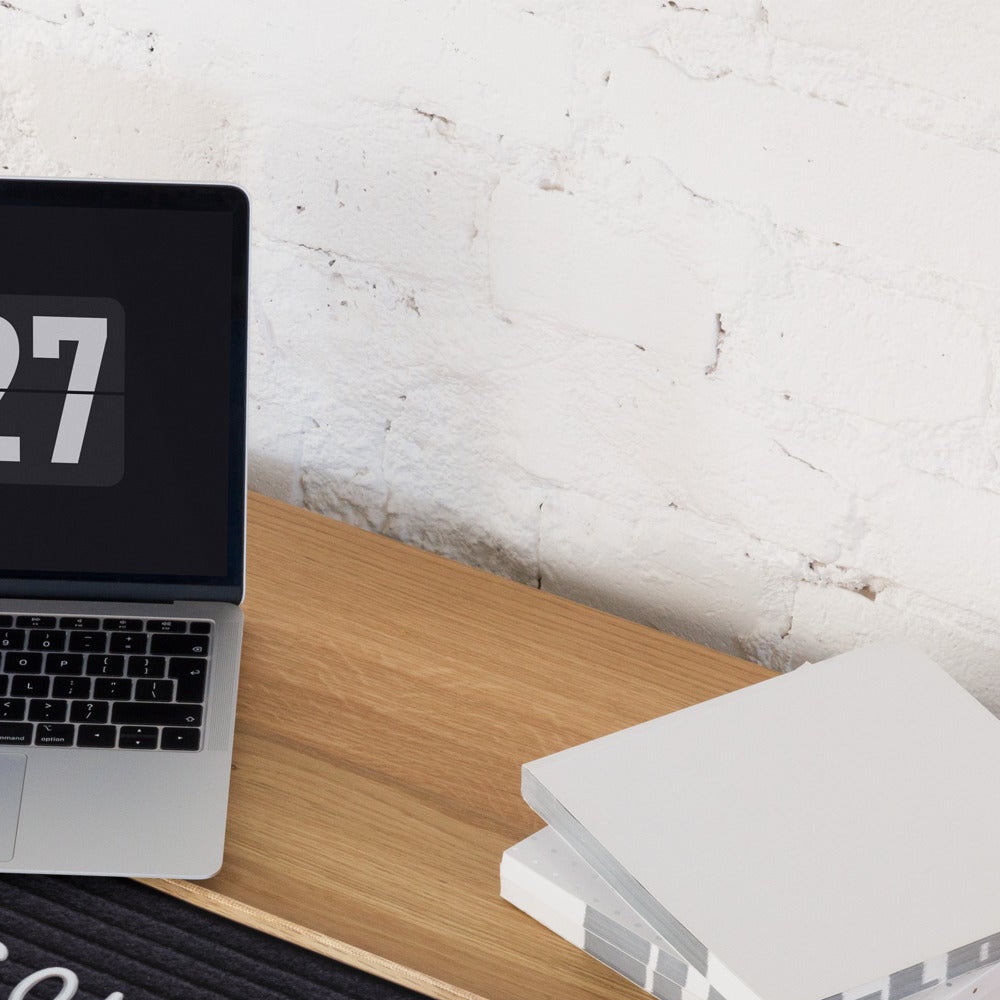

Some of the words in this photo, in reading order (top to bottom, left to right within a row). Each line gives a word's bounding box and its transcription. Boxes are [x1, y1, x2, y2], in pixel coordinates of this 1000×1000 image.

[1, 638, 10, 647] 9
[42, 640, 51, 648] 0
[18, 658, 28, 667] O
[59, 659, 69, 668] P
[26, 682, 34, 690] L
[40, 736, 66, 744] option
